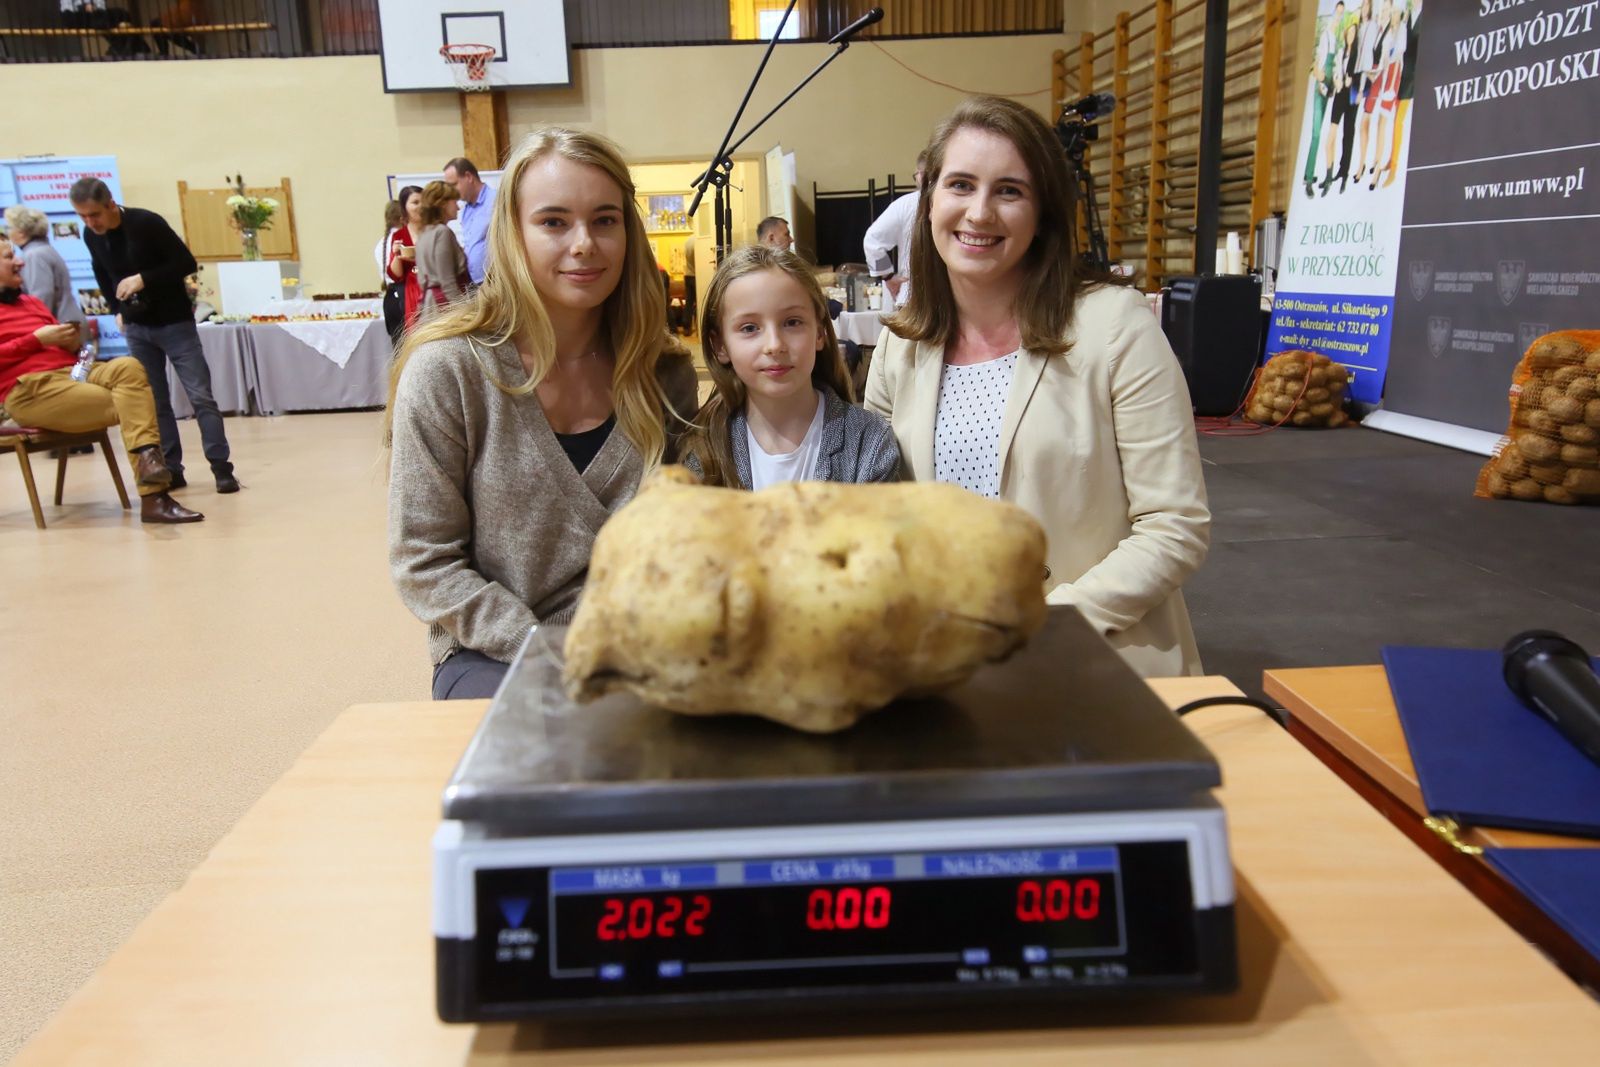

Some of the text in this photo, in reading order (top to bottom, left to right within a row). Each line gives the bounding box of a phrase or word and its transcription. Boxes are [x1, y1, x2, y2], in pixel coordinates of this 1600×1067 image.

[1434, 48, 1600, 110] WIELKOPOLSKI
[1464, 167, 1584, 200] www.umww.pl
[1300, 221, 1374, 249] Z TRADYCJĄ
[1288, 247, 1385, 277] W PRZYSZŁOŚĆ
[1331, 302, 1340, 314] ul.
[1341, 302, 1380, 319] Sikorskiego
[1381, 304, 1388, 317] 9
[1336, 320, 1345, 333] 62
[1347, 322, 1359, 334] 732
[806, 887, 891, 930] 0.00
[1016, 878, 1100, 922] 0.00
[597, 895, 711, 940] 2.022
